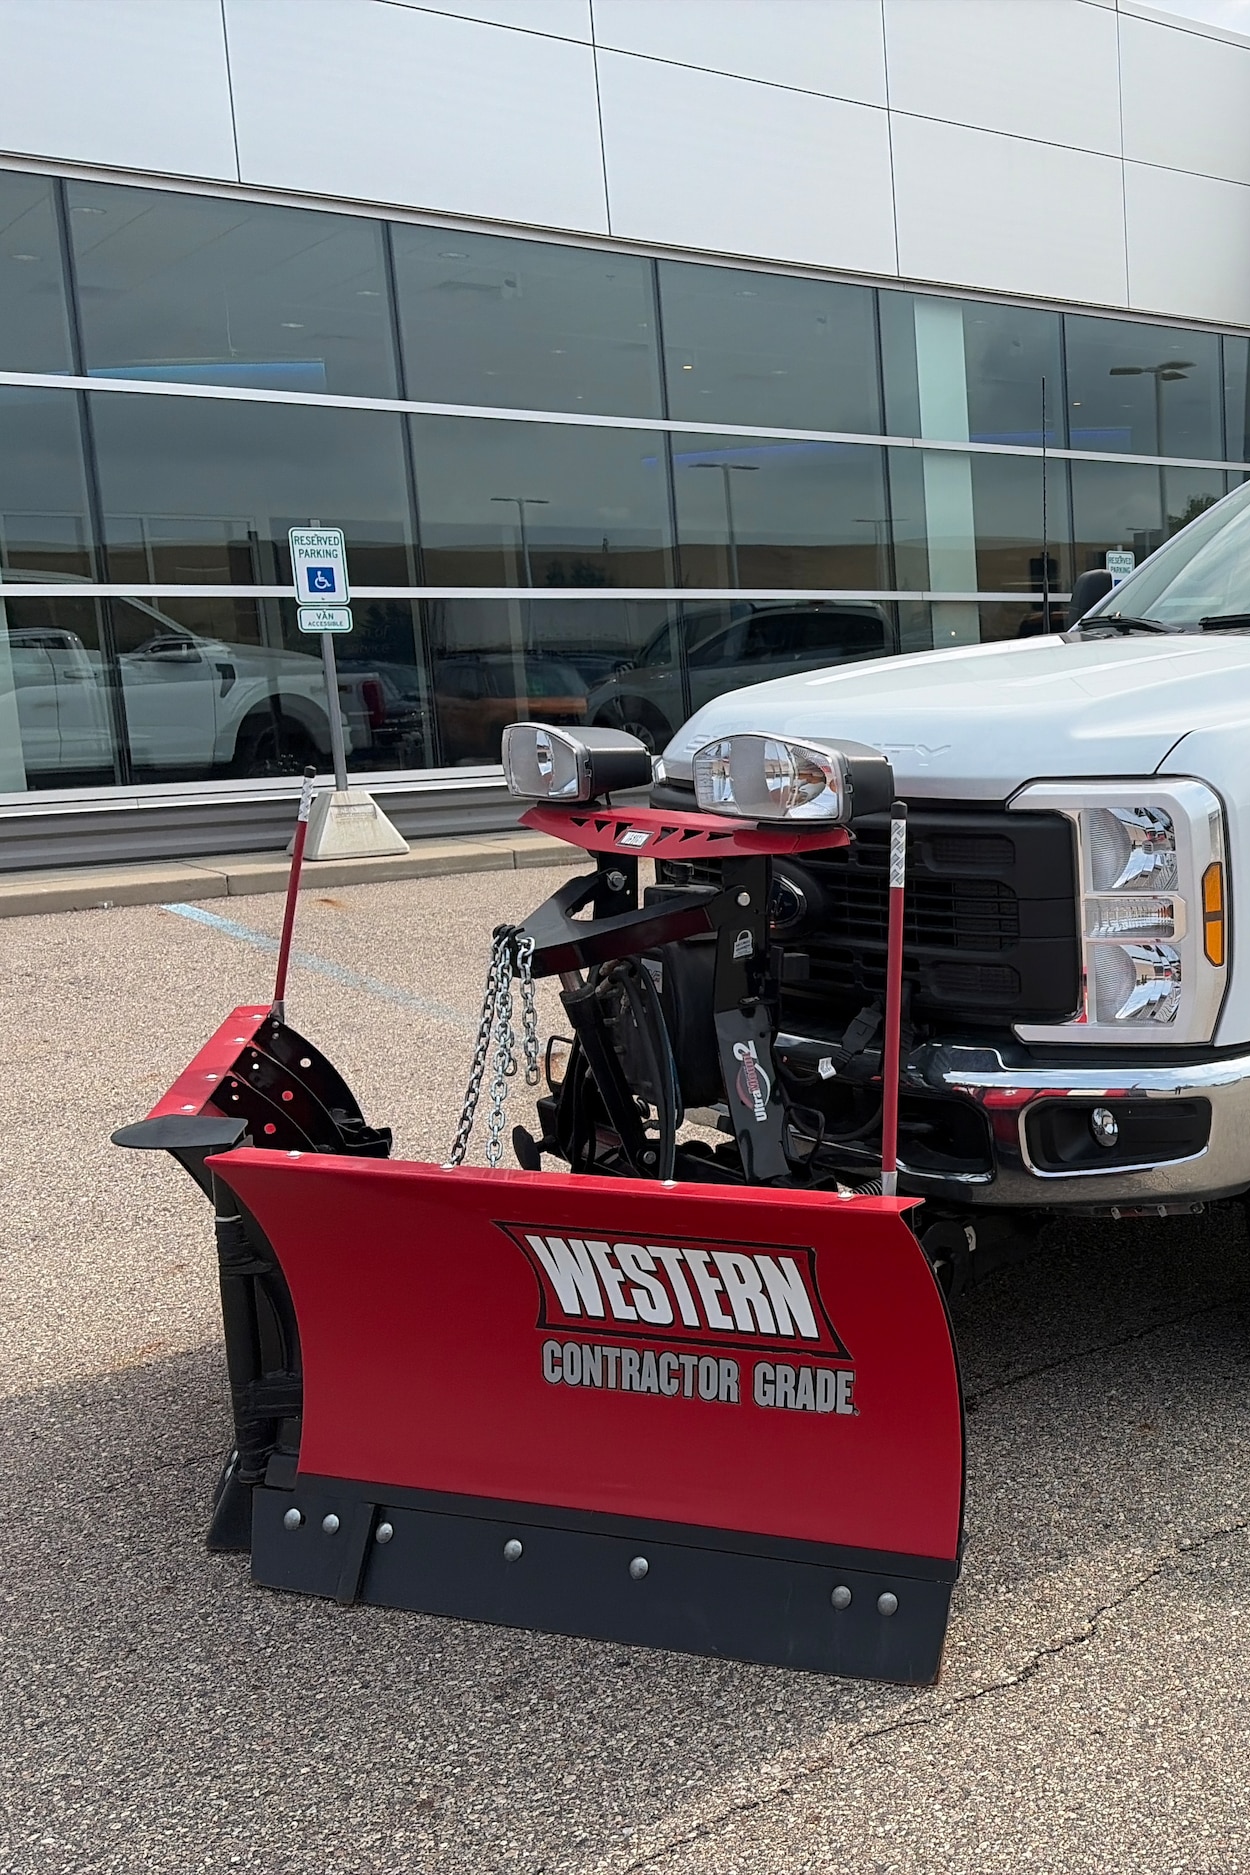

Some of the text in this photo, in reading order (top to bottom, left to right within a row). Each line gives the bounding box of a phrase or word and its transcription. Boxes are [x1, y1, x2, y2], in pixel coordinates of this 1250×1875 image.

[294, 535, 340, 546] RESERVED
[298, 548, 338, 559] PARKING
[316, 611, 334, 621] VAN
[308, 620, 343, 628] ACCESSIBLE
[524, 1235, 820, 1339] WESTERN
[542, 1339, 741, 1404] CONTRACTOR
